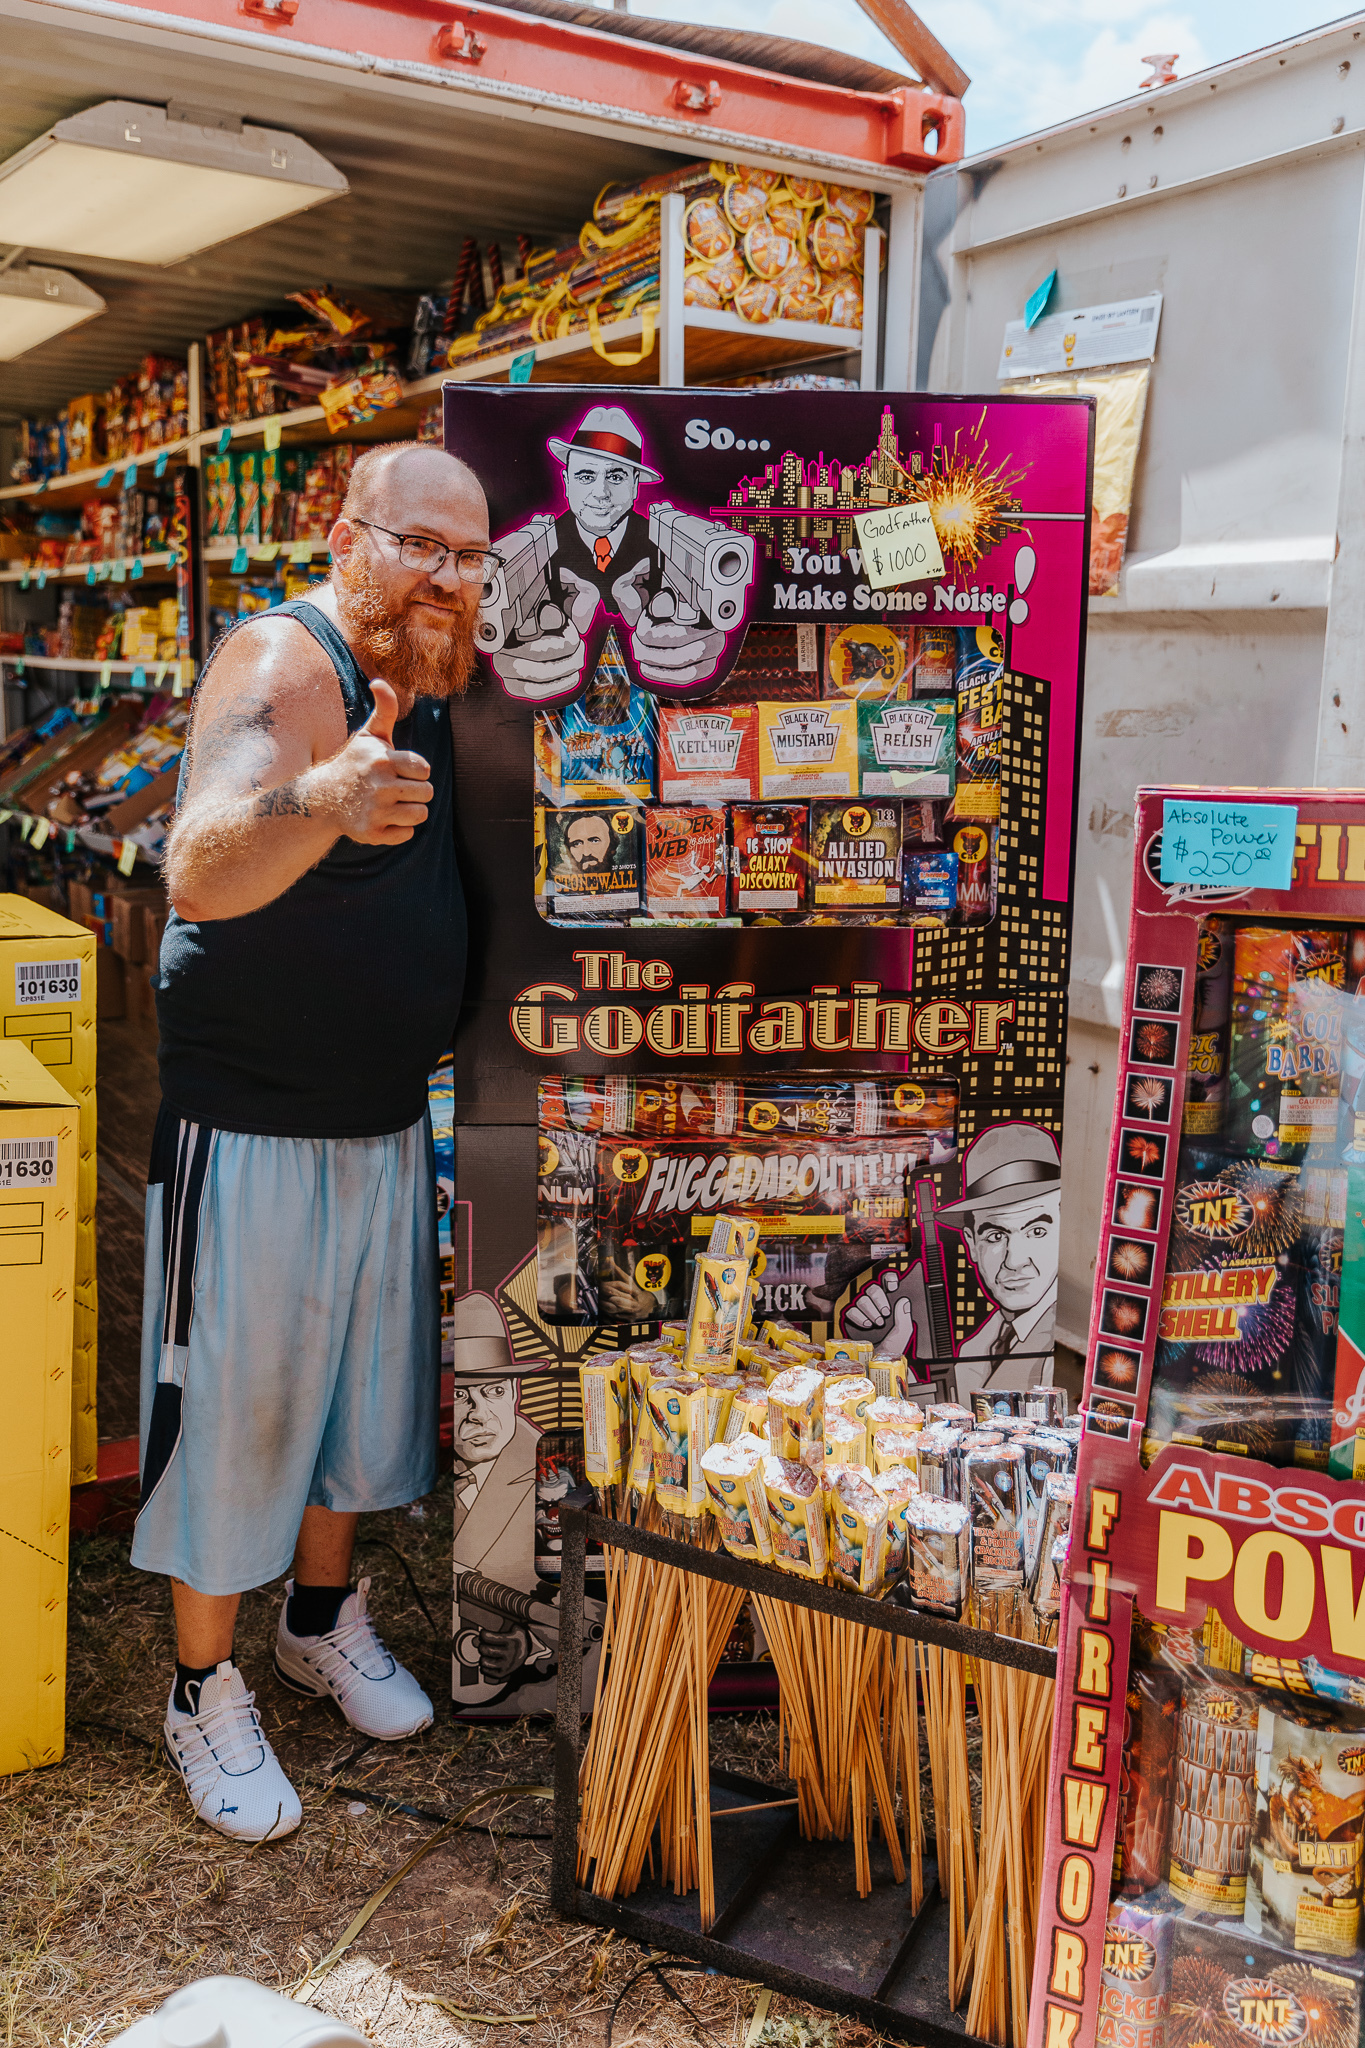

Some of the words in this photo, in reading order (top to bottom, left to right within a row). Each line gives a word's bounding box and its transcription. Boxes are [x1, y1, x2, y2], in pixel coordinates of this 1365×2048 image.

[684, 418, 771, 451] So...
[787, 547, 841, 575] You
[773, 583, 846, 611] Make
[852, 584, 928, 612] Some
[881, 645, 894, 680] Cat
[958, 676, 987, 692] BLACK
[685, 720, 709, 731] BLACK
[711, 720, 726, 731] CAT
[785, 713, 808, 725] BLACK
[810, 713, 825, 724] CAT
[889, 713, 913, 724] BLACK
[914, 713, 929, 725] CAT
[677, 740, 735, 754] KETCHUP
[777, 733, 834, 748] MUSTARD
[883, 733, 933, 748] RELISH
[876, 808, 895, 821] 18
[1167, 808, 1249, 828] Absolute
[655, 814, 715, 840] SPIDER
[746, 837, 759, 854] 16
[763, 837, 793, 854] SHOT
[1211, 828, 1278, 846] Power
[648, 838, 689, 860] WEB
[827, 841, 886, 859] ALLIED
[749, 855, 789, 872] GALAXY
[818, 860, 895, 878] INVASION
[554, 870, 638, 893] STONEWALL
[739, 872, 798, 889] DISCOVERY
[573, 950, 673, 991] The
[1305, 961, 1342, 986] TNT
[18, 978, 79, 996] 101630
[509, 981, 1015, 1057] Godfather
[604, 1084, 612, 1122] CAUTON
[621, 1172, 638, 1180] Cat
[1190, 1197, 1237, 1224] TNT
[1229, 1256, 1276, 1267] ASSORTED
[644, 1280, 662, 1288] Cat
[698, 1321, 719, 1330] TEXAS
[1158, 1304, 1242, 1342] SHELL
[655, 1460, 661, 1468] &
[657, 1468, 683, 1480] ROCKET
[973, 1527, 998, 1539] TEXAS
[1000, 1528, 1020, 1540] LOUD
[974, 1546, 1019, 1558] CRACKLING
[980, 1538, 987, 1546] &
[988, 1538, 1015, 1549] PROUD
[983, 1555, 1013, 1566] ROCKET
[1212, 1621, 1220, 1648] CAUTION
[1206, 1700, 1234, 1716] TNT
[1175, 1757, 1256, 1823] STARS
[1187, 1877, 1228, 1892] WARNING
[1104, 1943, 1144, 1965] TNT
[1240, 1999, 1290, 2025] TNT
[1096, 2020, 1165, 2048] ASER
